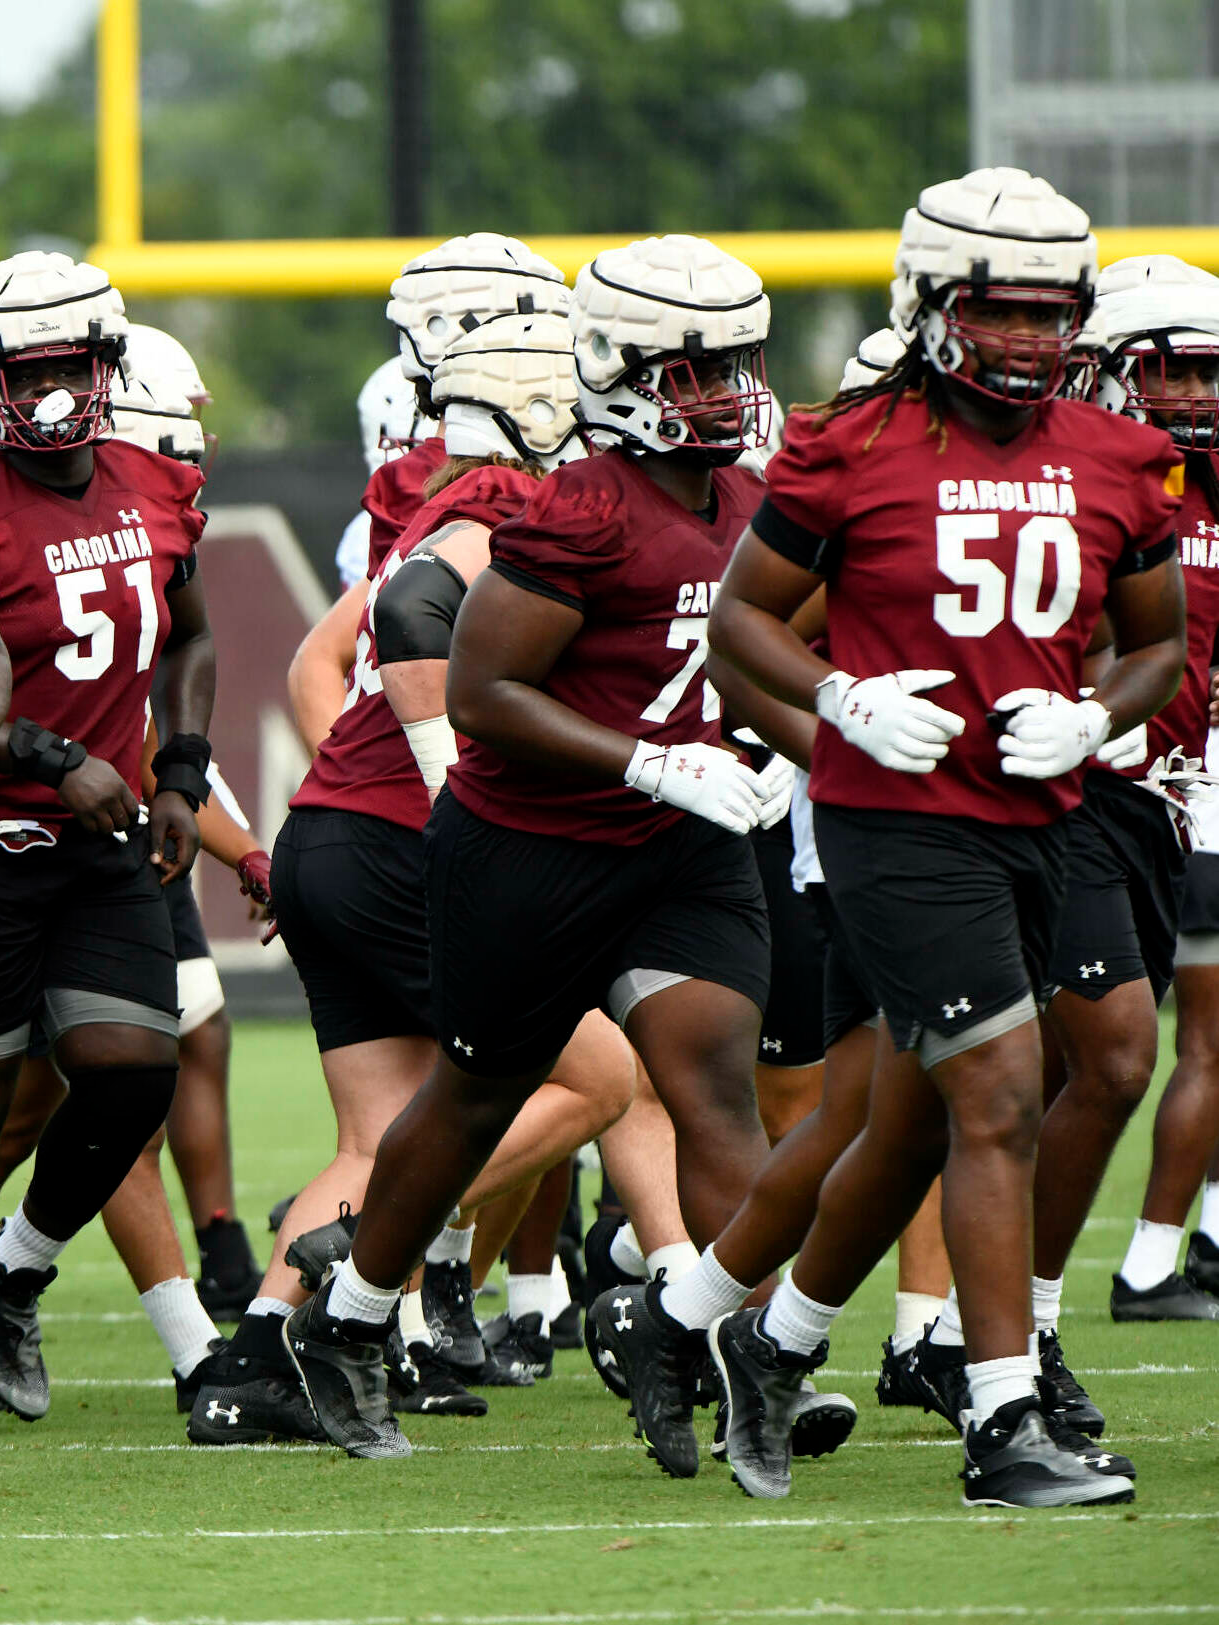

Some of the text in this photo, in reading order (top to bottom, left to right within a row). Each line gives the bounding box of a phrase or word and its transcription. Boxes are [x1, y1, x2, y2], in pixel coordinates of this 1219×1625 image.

[44, 526, 153, 574] CAROLINA
[937, 479, 1078, 517] CAROLINA
[54, 559, 159, 681] 51
[933, 513, 1082, 639] 50
[639, 617, 721, 724] 7
